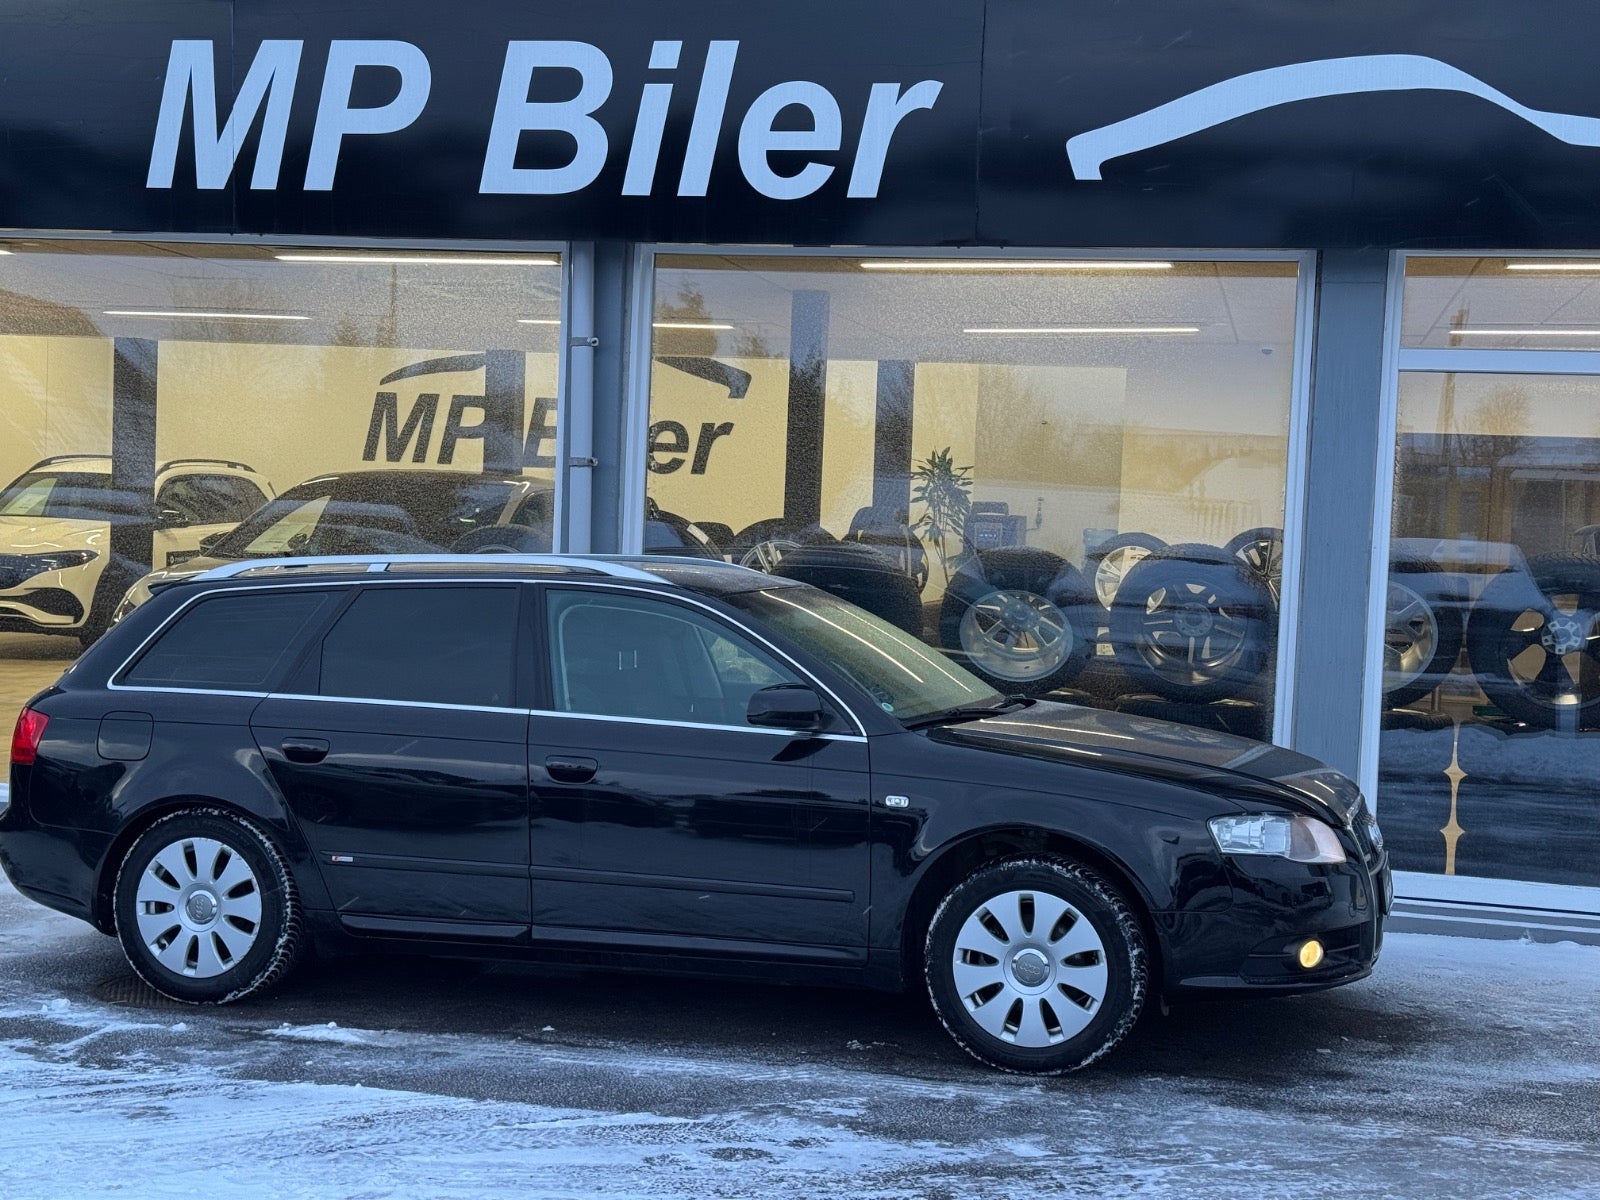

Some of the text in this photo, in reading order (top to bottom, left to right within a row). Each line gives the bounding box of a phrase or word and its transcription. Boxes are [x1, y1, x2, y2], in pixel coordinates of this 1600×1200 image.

[146, 39, 943, 199] MP Biler
[362, 391, 735, 476] MP Ber
